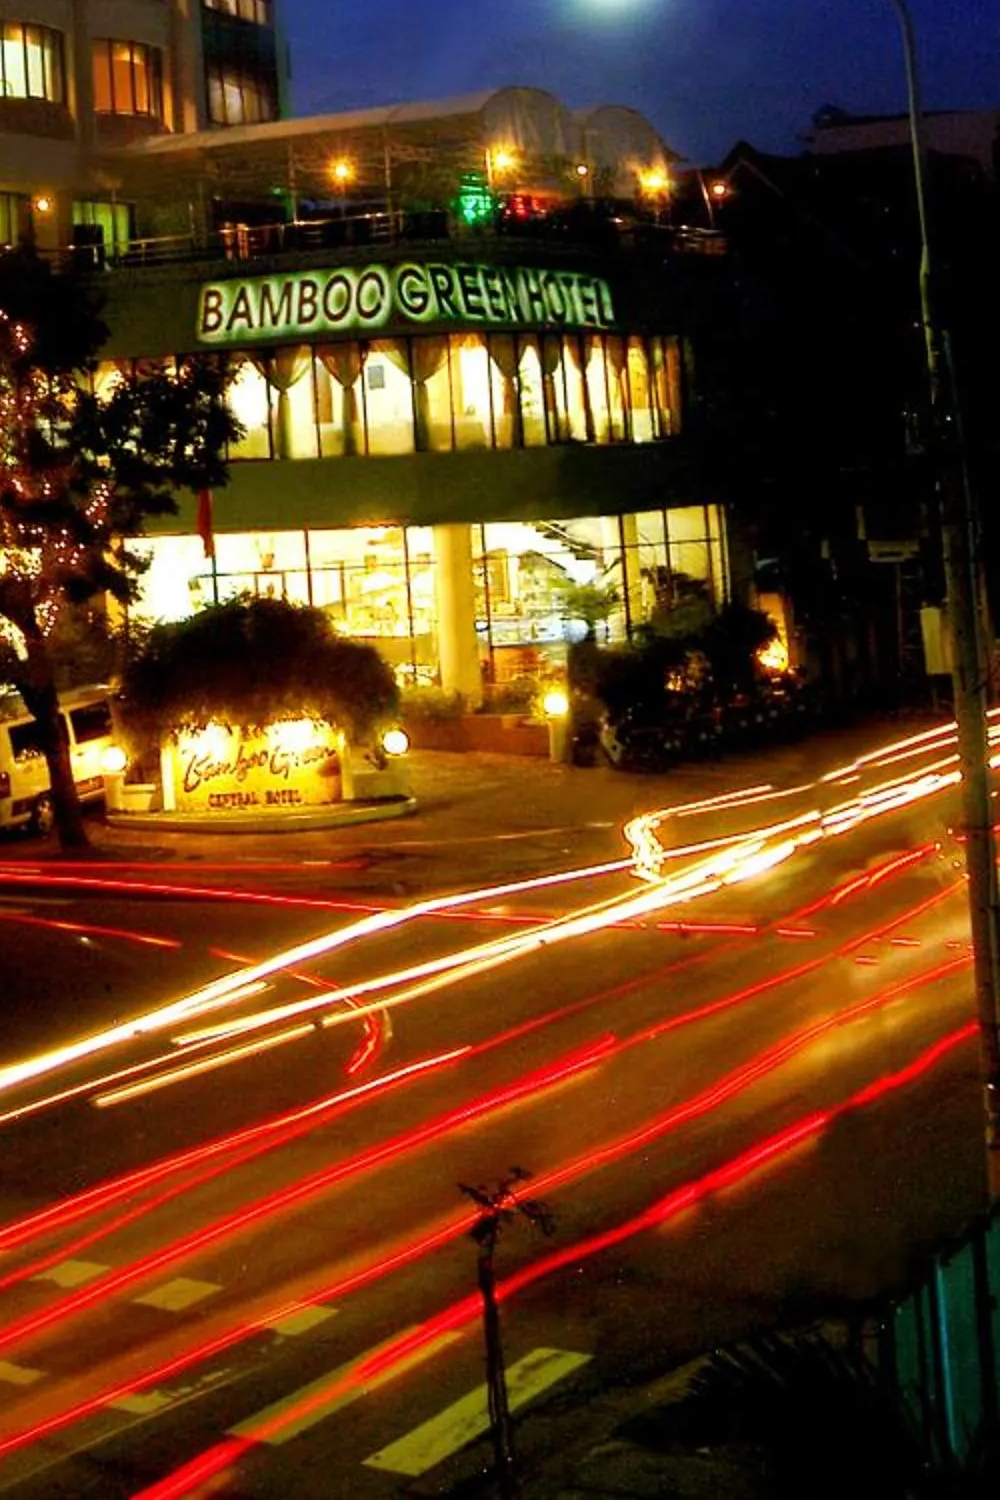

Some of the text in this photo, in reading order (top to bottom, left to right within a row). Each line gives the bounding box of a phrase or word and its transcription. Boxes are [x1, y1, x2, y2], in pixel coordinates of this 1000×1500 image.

[201, 266, 615, 333] BAMBOO GREEN HOTEL
[183, 745, 269, 792] Bamboo
[265, 789, 302, 805] HOTEL
